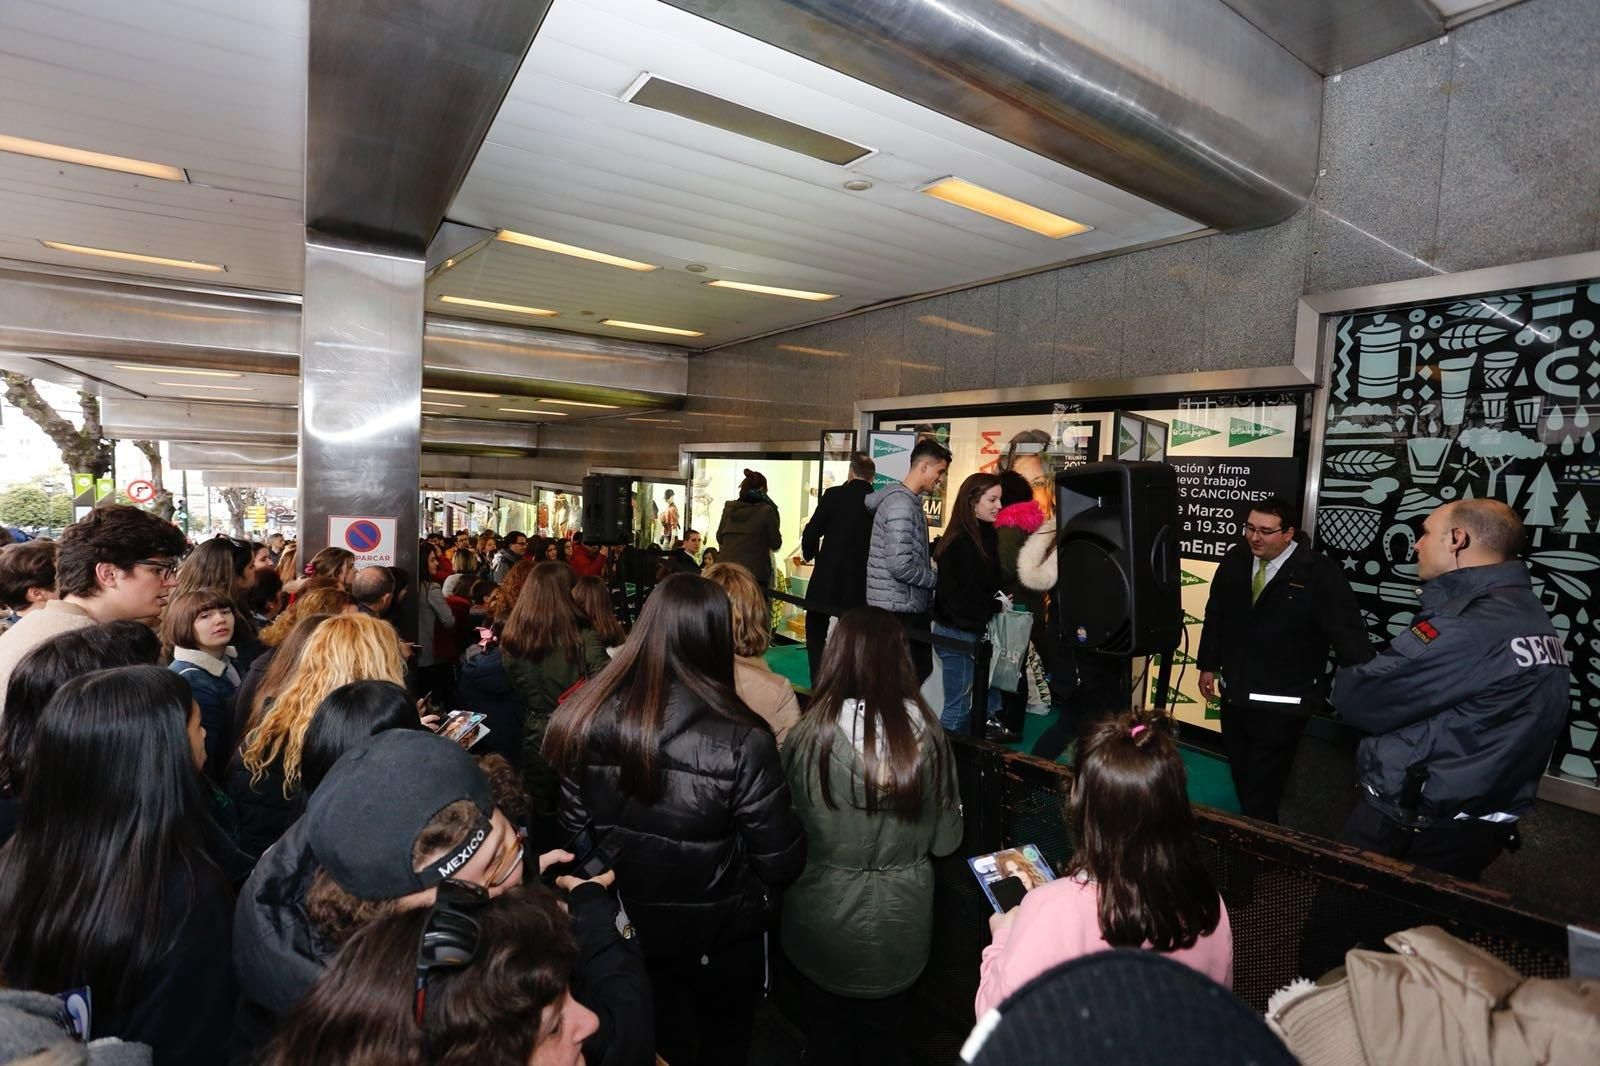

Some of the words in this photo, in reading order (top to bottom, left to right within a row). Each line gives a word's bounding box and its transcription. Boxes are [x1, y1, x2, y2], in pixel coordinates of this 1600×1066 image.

[1170, 464, 1204, 474] ación
[1207, 466, 1215, 475] y
[1218, 464, 1250, 475] firma
[1204, 476, 1247, 488] trabajo
[1188, 504, 1234, 518] Marzo
[1184, 522, 1192, 531] a
[1196, 520, 1236, 535] 19.30
[438, 830, 484, 878] MEXICO
